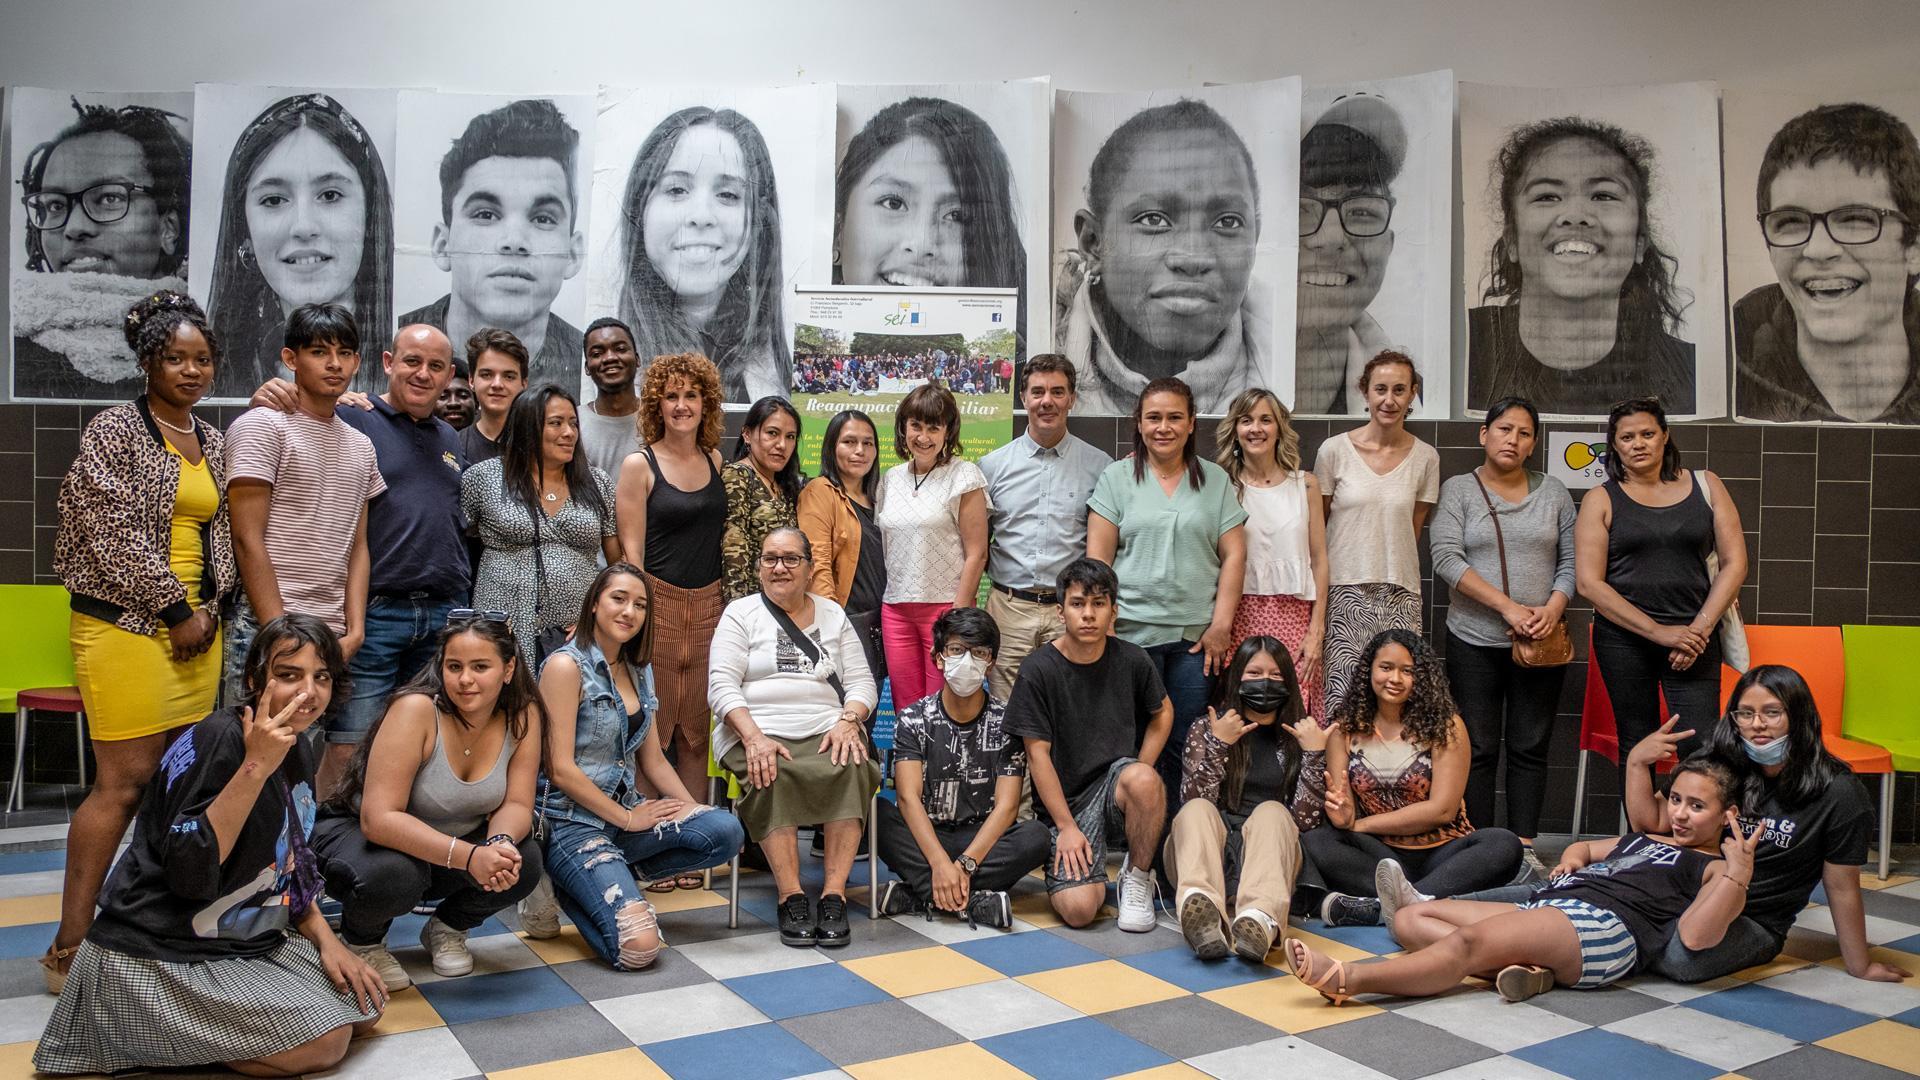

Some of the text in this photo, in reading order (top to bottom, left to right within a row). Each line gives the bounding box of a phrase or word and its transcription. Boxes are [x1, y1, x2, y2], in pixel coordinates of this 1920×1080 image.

[806, 398, 999, 415] Reagrupaci iliar
[1584, 468, 1604, 478] se
[1779, 819, 1796, 833] &
[1635, 843, 1682, 865] NEED
